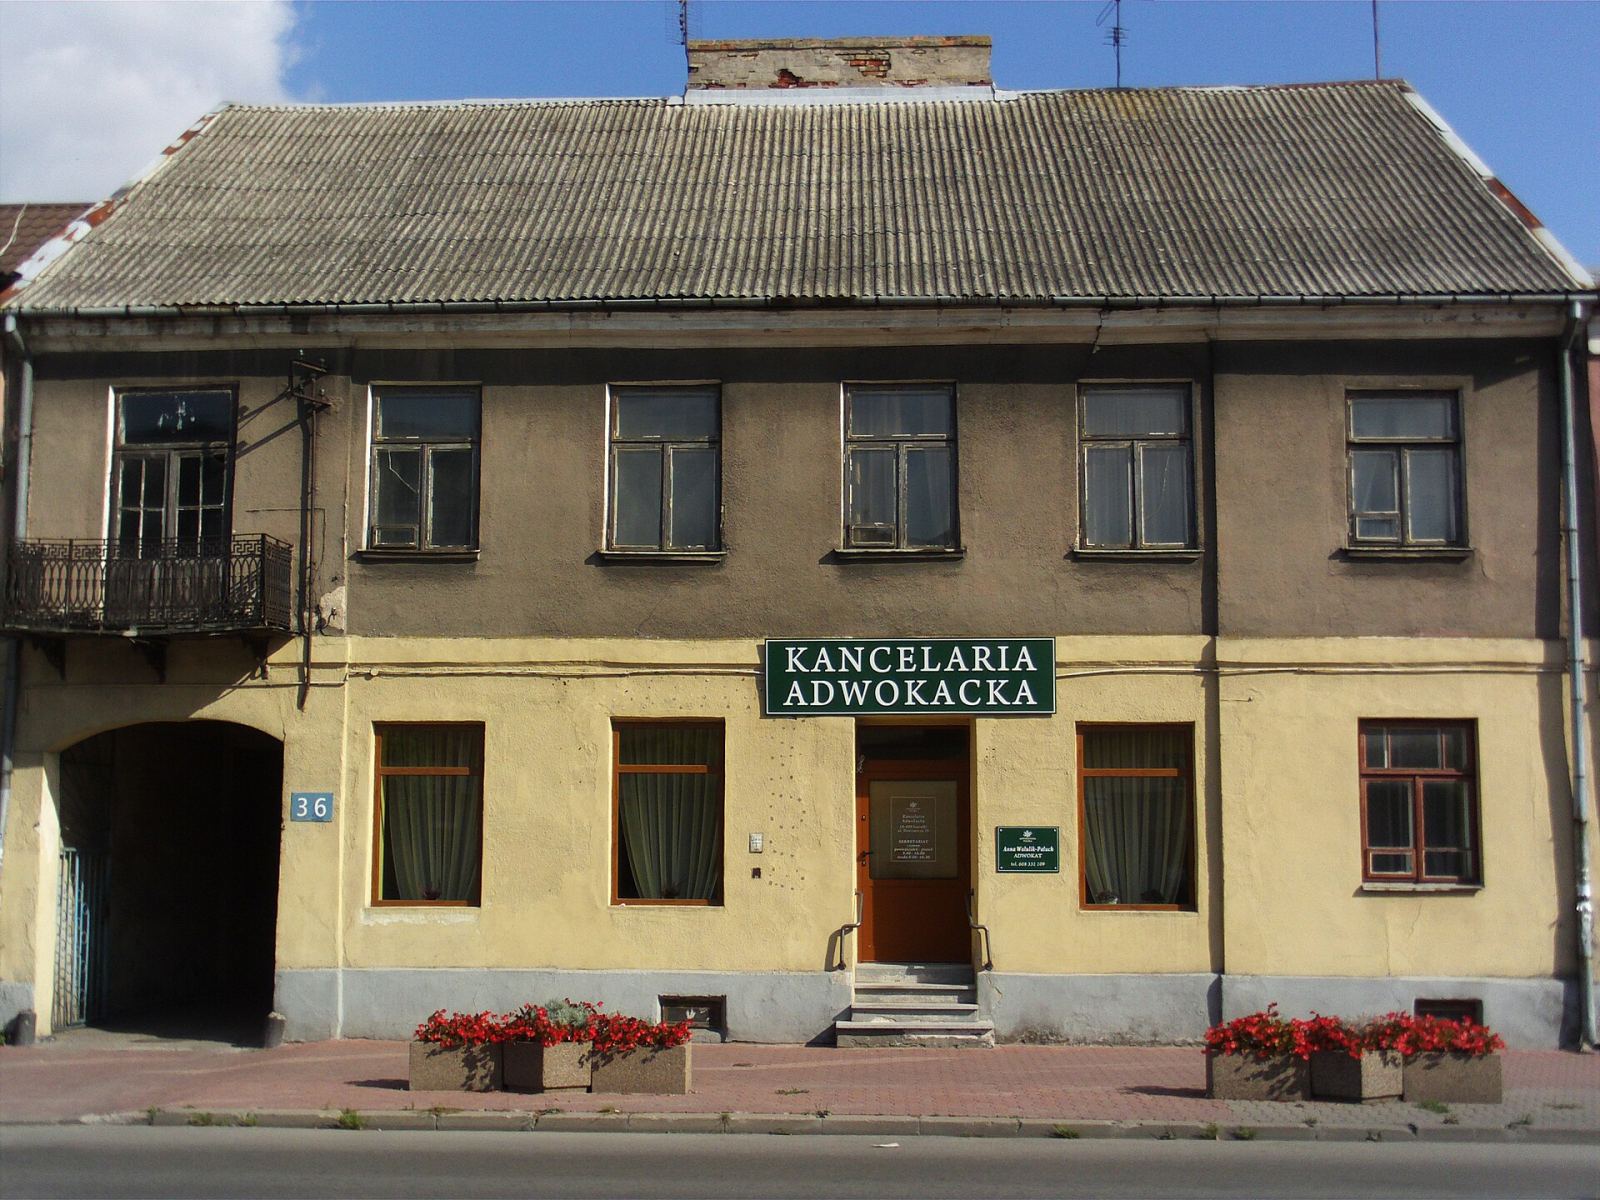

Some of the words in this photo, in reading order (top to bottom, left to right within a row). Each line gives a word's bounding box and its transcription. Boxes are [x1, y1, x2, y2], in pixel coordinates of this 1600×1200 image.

[784, 645, 1038, 673] KANCELARIA
[782, 679, 1038, 706] ADWOKACKA
[296, 797, 327, 817] 36
